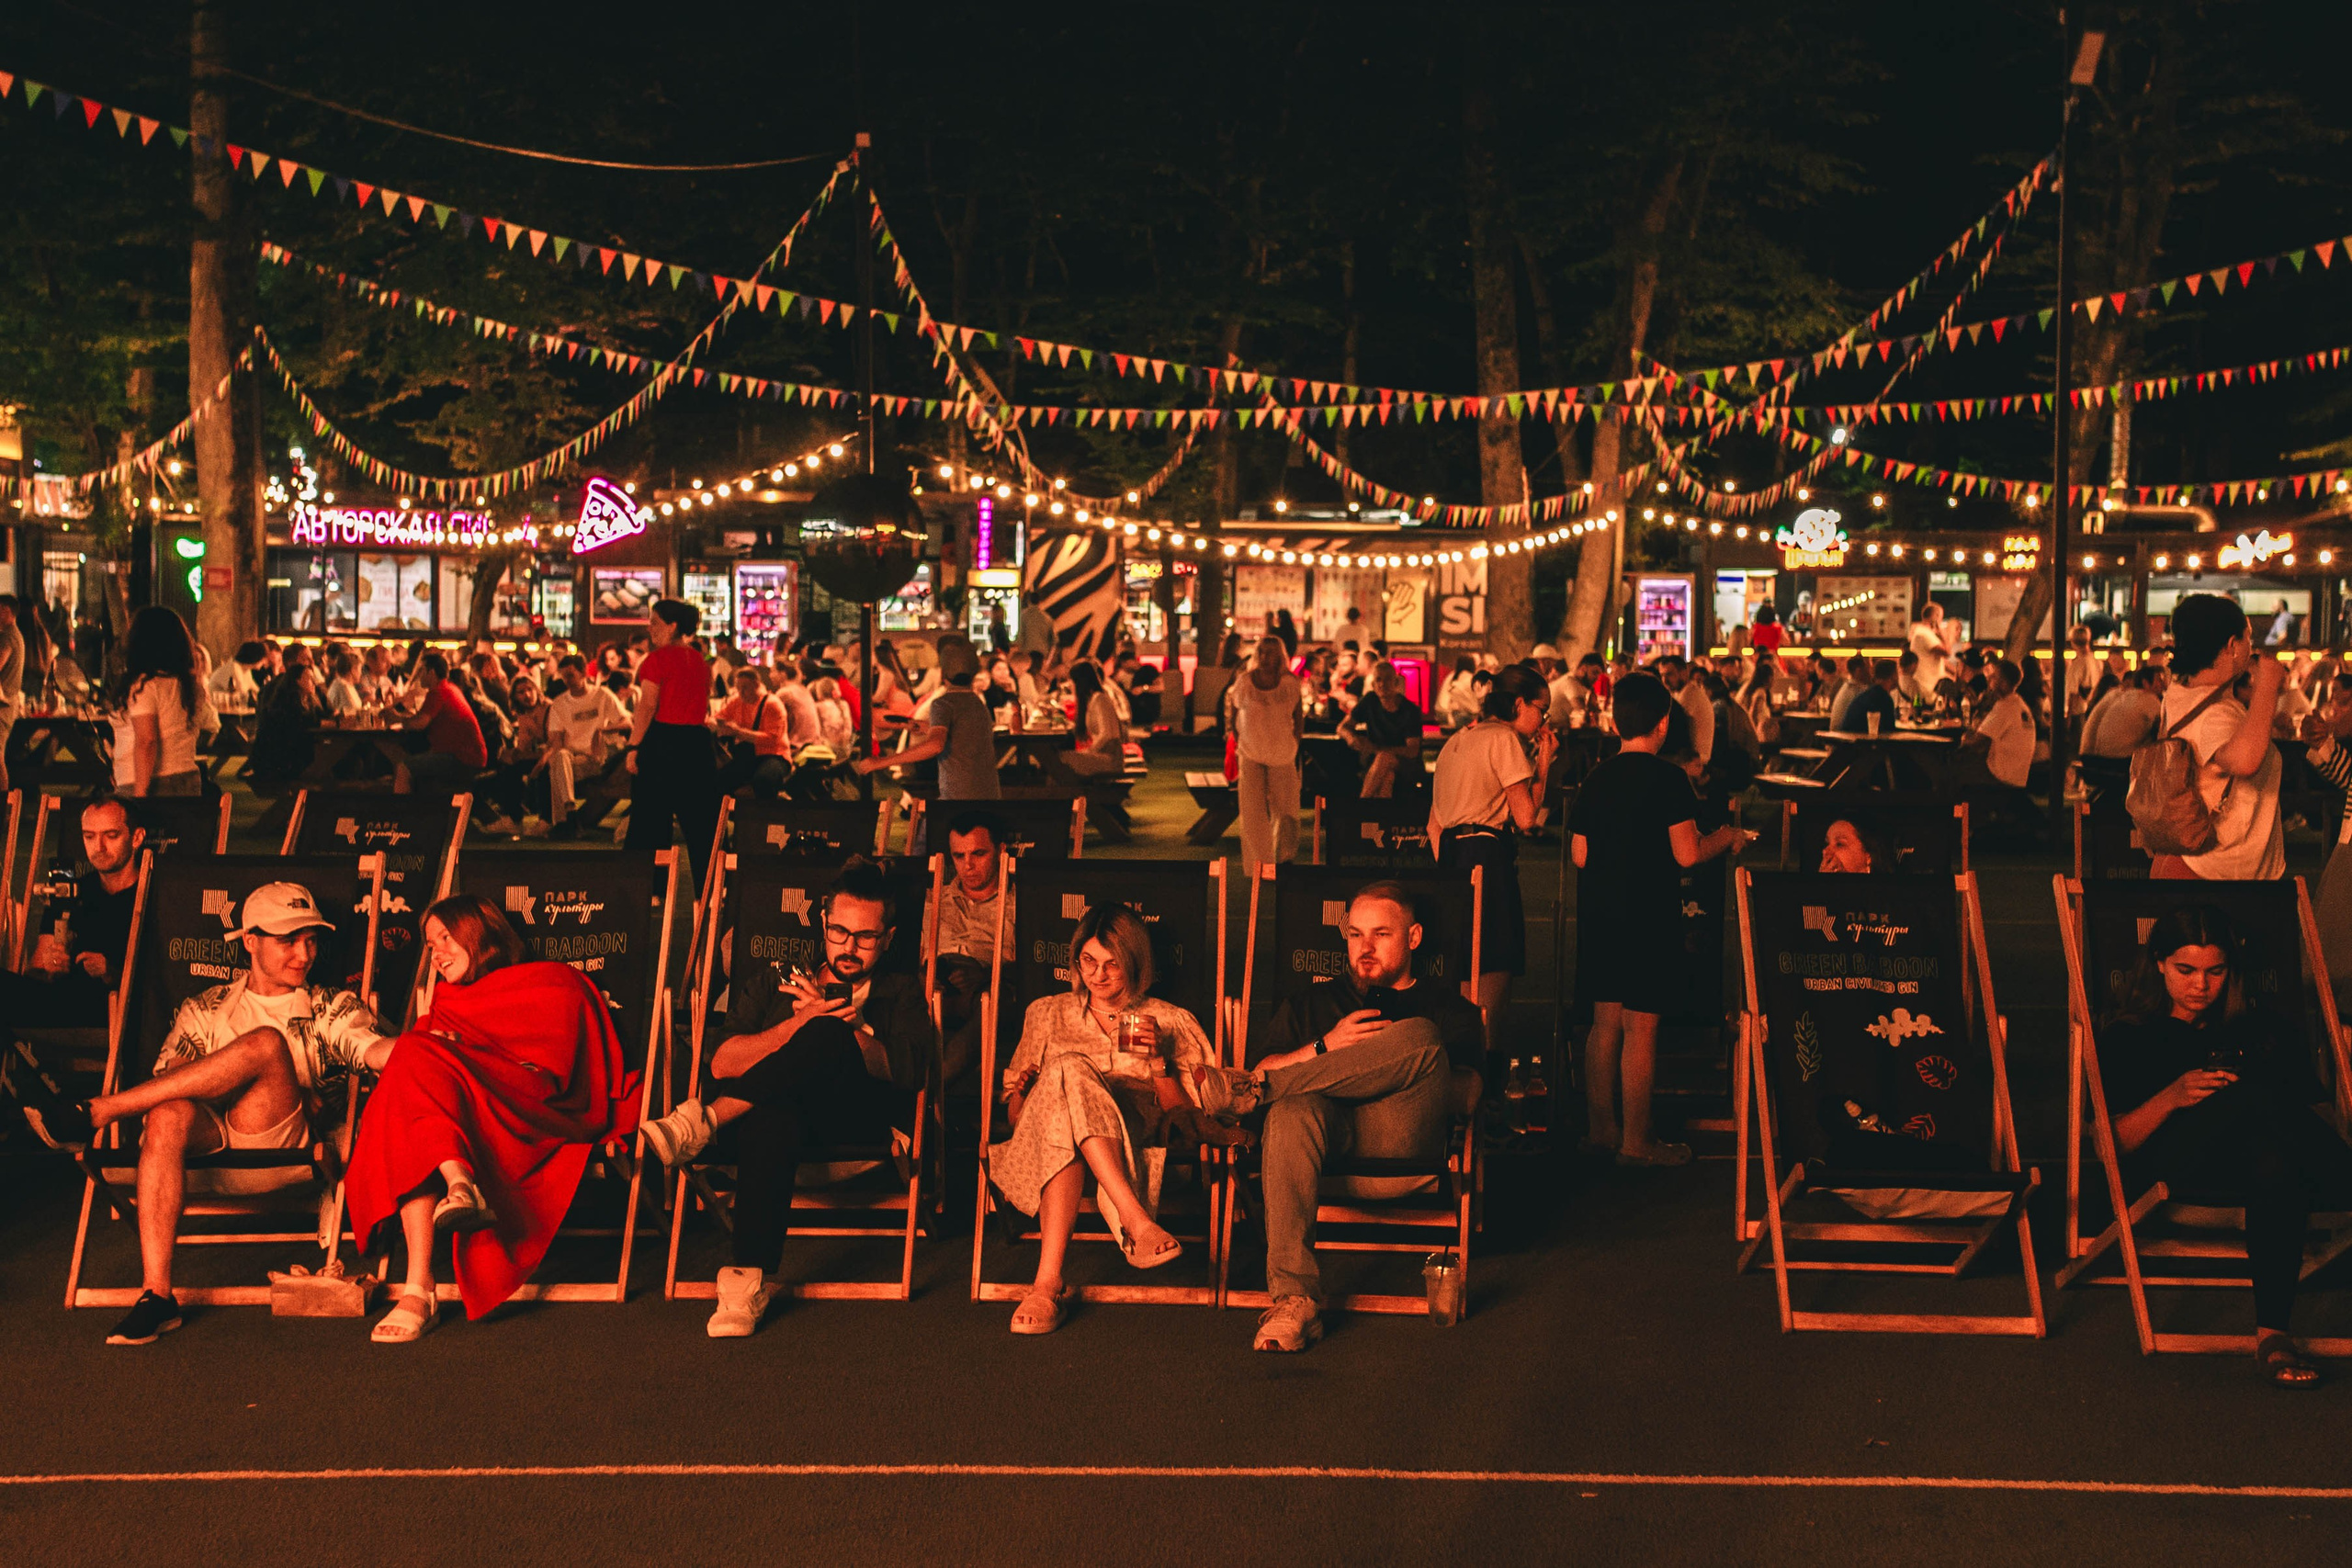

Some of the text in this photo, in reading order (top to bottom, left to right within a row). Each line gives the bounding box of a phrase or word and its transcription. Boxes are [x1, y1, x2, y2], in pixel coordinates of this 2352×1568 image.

[292, 511, 443, 546] АВТОРСКАЯ
[1440, 596, 1485, 635] SI
[545, 891, 588, 903] ПАРК
[545, 901, 605, 926] культуры
[1846, 912, 1891, 924] ПАРК
[546, 931, 628, 960] BABOON
[1847, 922, 1909, 947] культуры
[169, 937, 239, 964] GREEN
[750, 935, 816, 963] GREEN
[189, 962, 230, 981] URBAN
[1779, 951, 1848, 976] GREEN
[1804, 977, 1843, 991] URBAN
[1897, 981, 1919, 994] GIN
